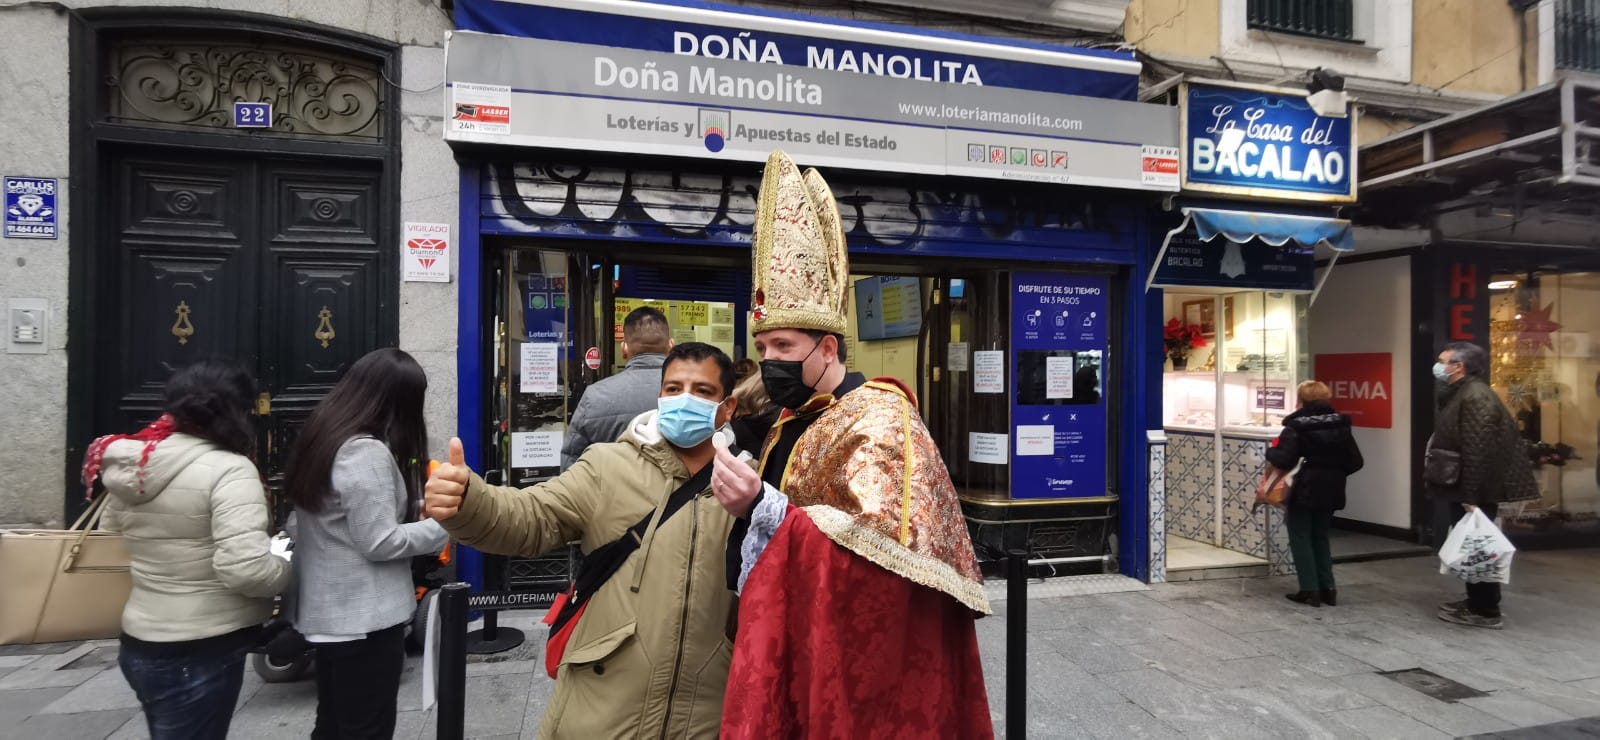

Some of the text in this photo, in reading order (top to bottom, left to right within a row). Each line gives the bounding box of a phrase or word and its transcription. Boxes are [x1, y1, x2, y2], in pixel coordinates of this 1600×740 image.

[673, 31, 984, 87] DOÑA MANOLITA
[594, 56, 823, 106] Doña Manolita
[240, 107, 264, 122] 22
[898, 102, 1083, 132] www.loteriamanolita.com
[1205, 104, 1334, 145] La Casa del
[606, 114, 897, 151] Loterías y Apuestas del Estado
[1192, 137, 1344, 184] BACALAO
[7, 180, 54, 190] CARLÚS
[407, 225, 448, 233] VIGILADO
[1018, 284, 1101, 296] DISFRUTE DE SU TIEMPO
[1040, 295, 1080, 305] EN 3 PASOS
